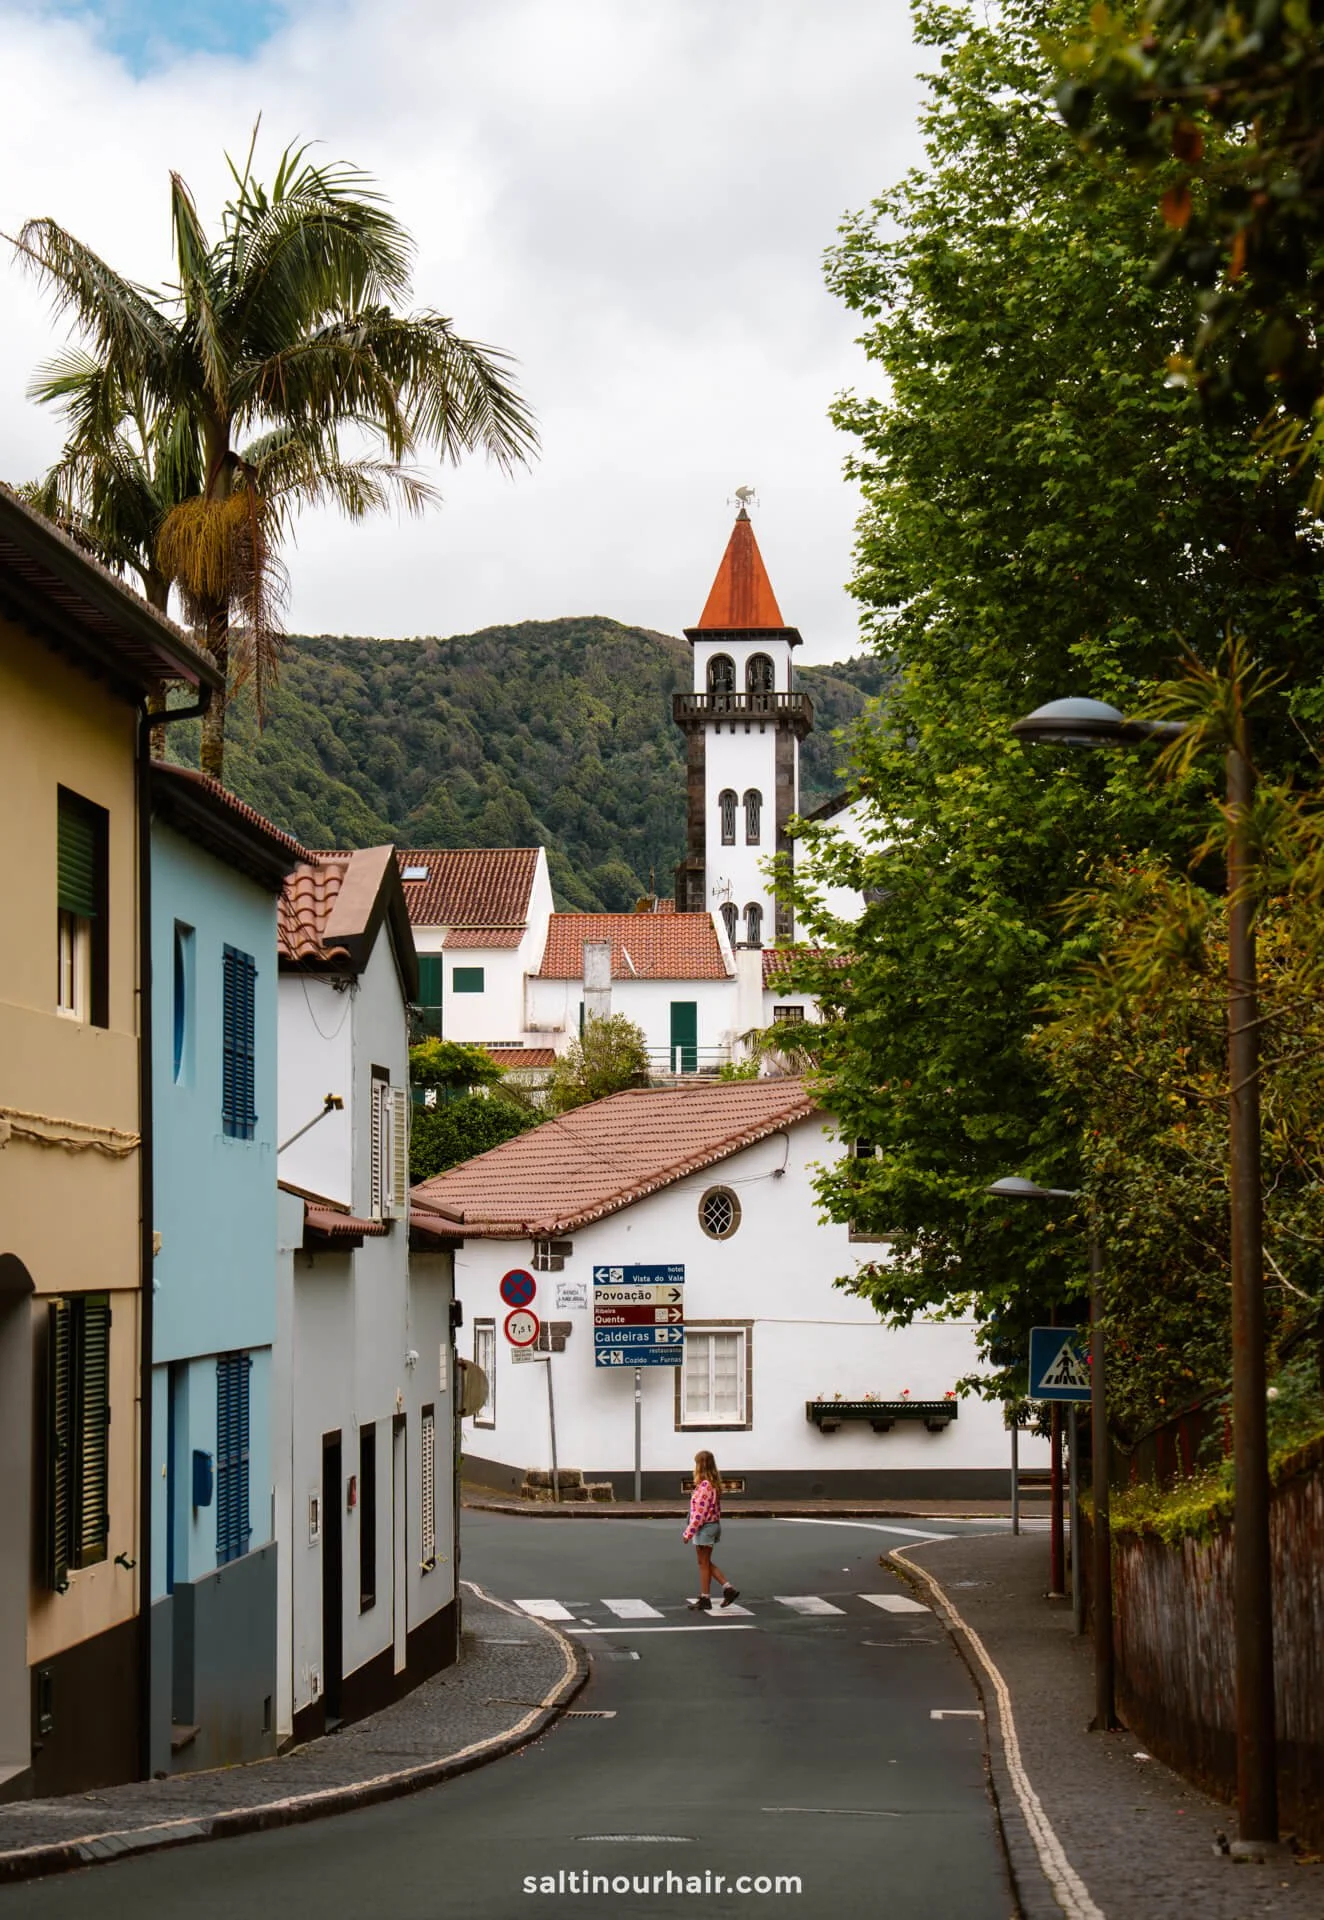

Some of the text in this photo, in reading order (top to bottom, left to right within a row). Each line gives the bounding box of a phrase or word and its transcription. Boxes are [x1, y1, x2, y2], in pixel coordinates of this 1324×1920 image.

[668, 1274, 683, 1282] Vale
[595, 1290, 651, 1303] Povoação
[595, 1315, 625, 1324] Quente
[595, 1332, 649, 1342] Caldeiras
